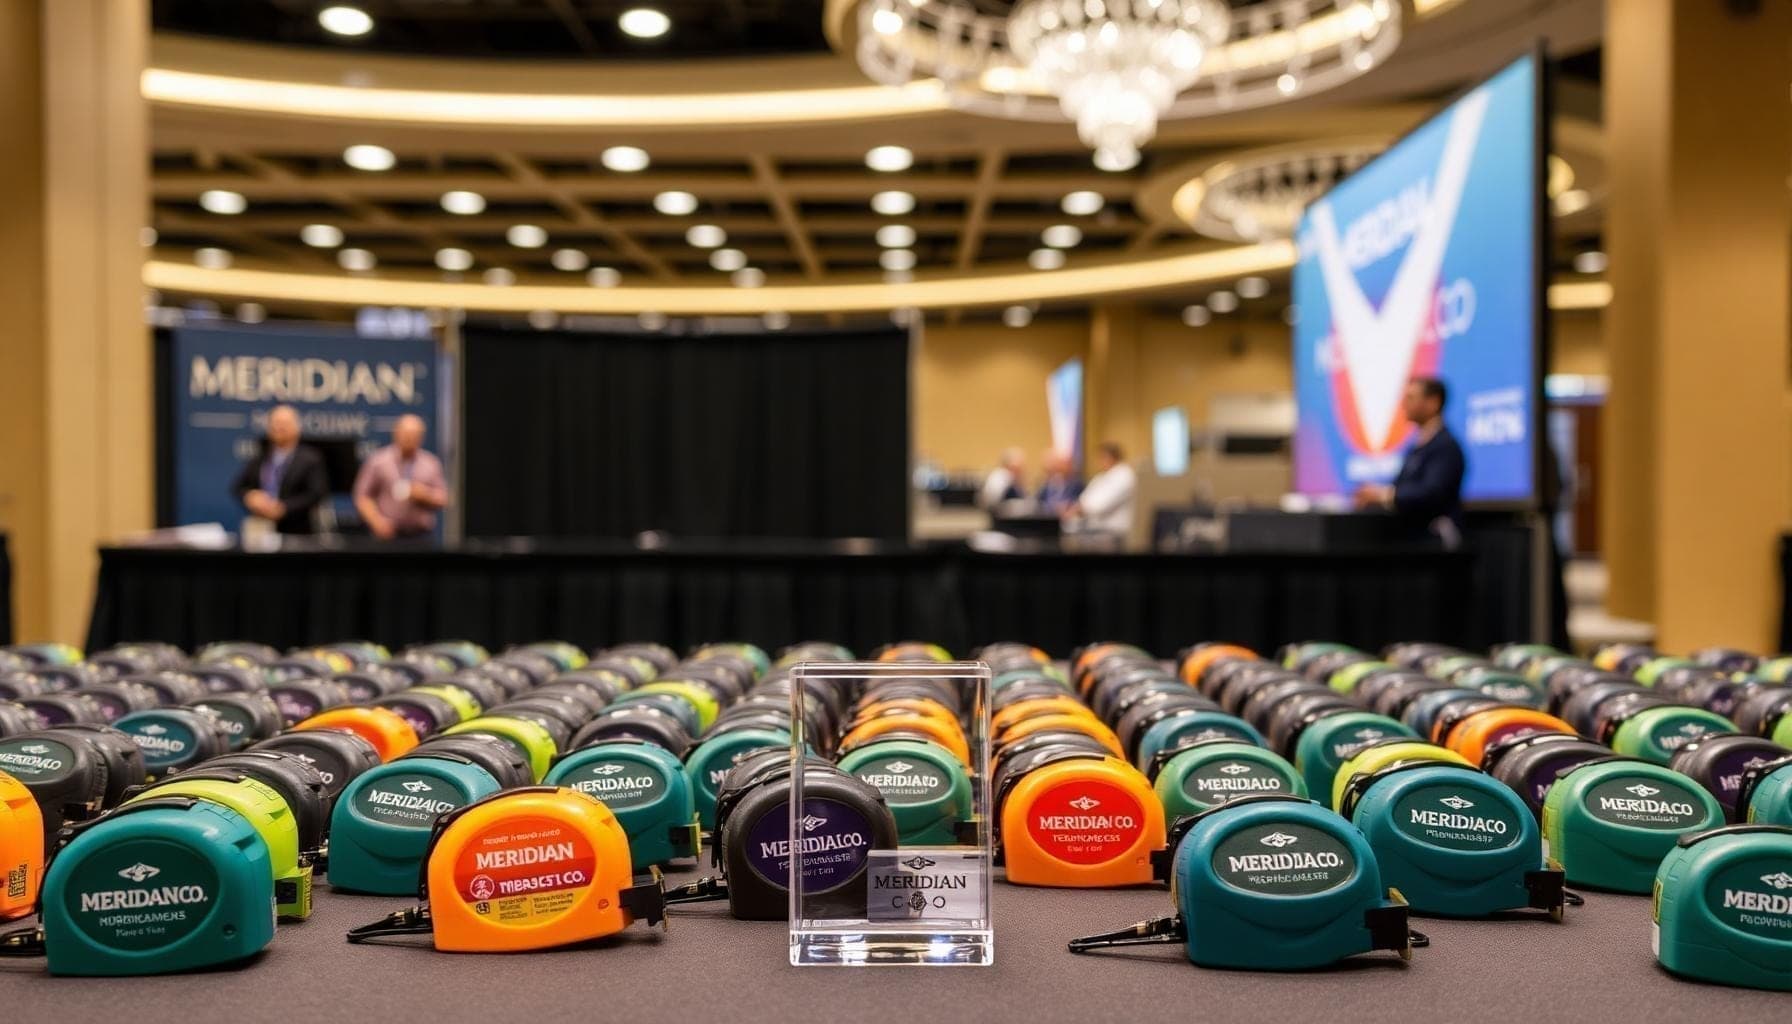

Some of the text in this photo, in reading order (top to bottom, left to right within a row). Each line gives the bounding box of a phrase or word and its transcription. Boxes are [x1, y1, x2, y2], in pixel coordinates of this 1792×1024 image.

[190, 355, 415, 404] MERIDIAN
[475, 842, 574, 870] MERIDIAN
[874, 875, 967, 889] MERIDIAN
